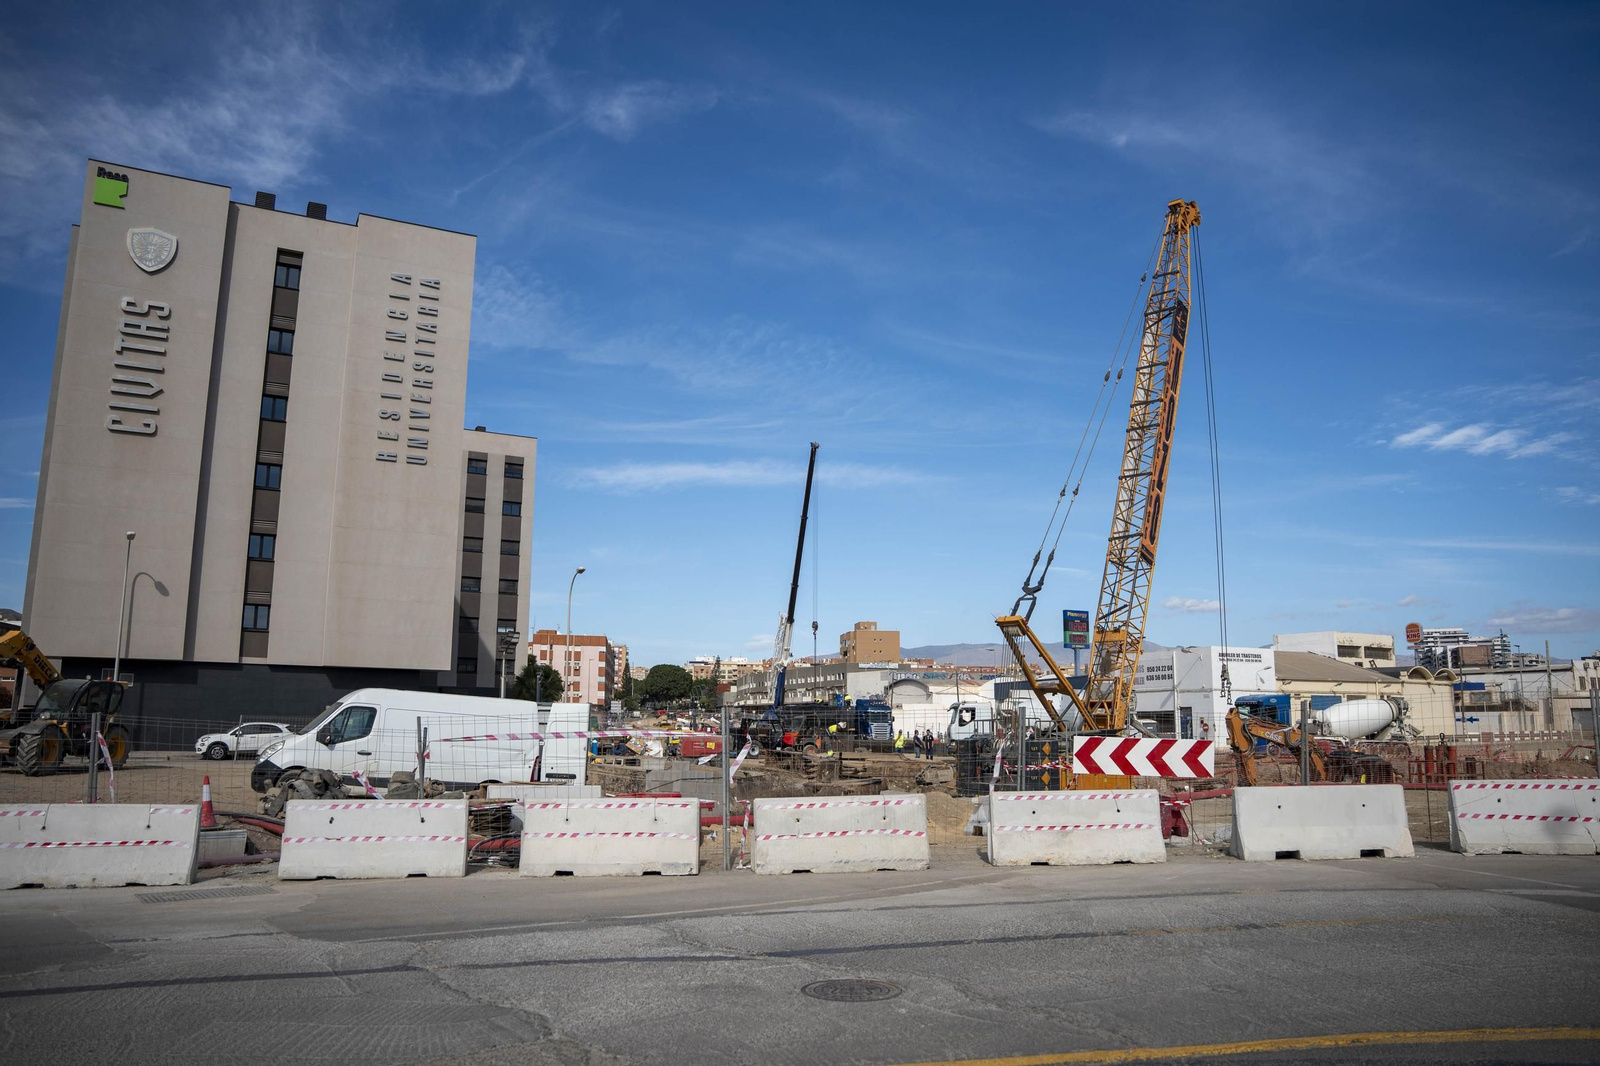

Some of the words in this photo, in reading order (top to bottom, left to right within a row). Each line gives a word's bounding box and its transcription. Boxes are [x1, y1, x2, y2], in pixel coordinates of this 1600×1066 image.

[106, 296, 171, 437] CIVITAS
[375, 272, 412, 463] RESIDENCIA
[406, 278, 440, 465] UNIVERSITARIA
[1265, 731, 1283, 742] CASE
